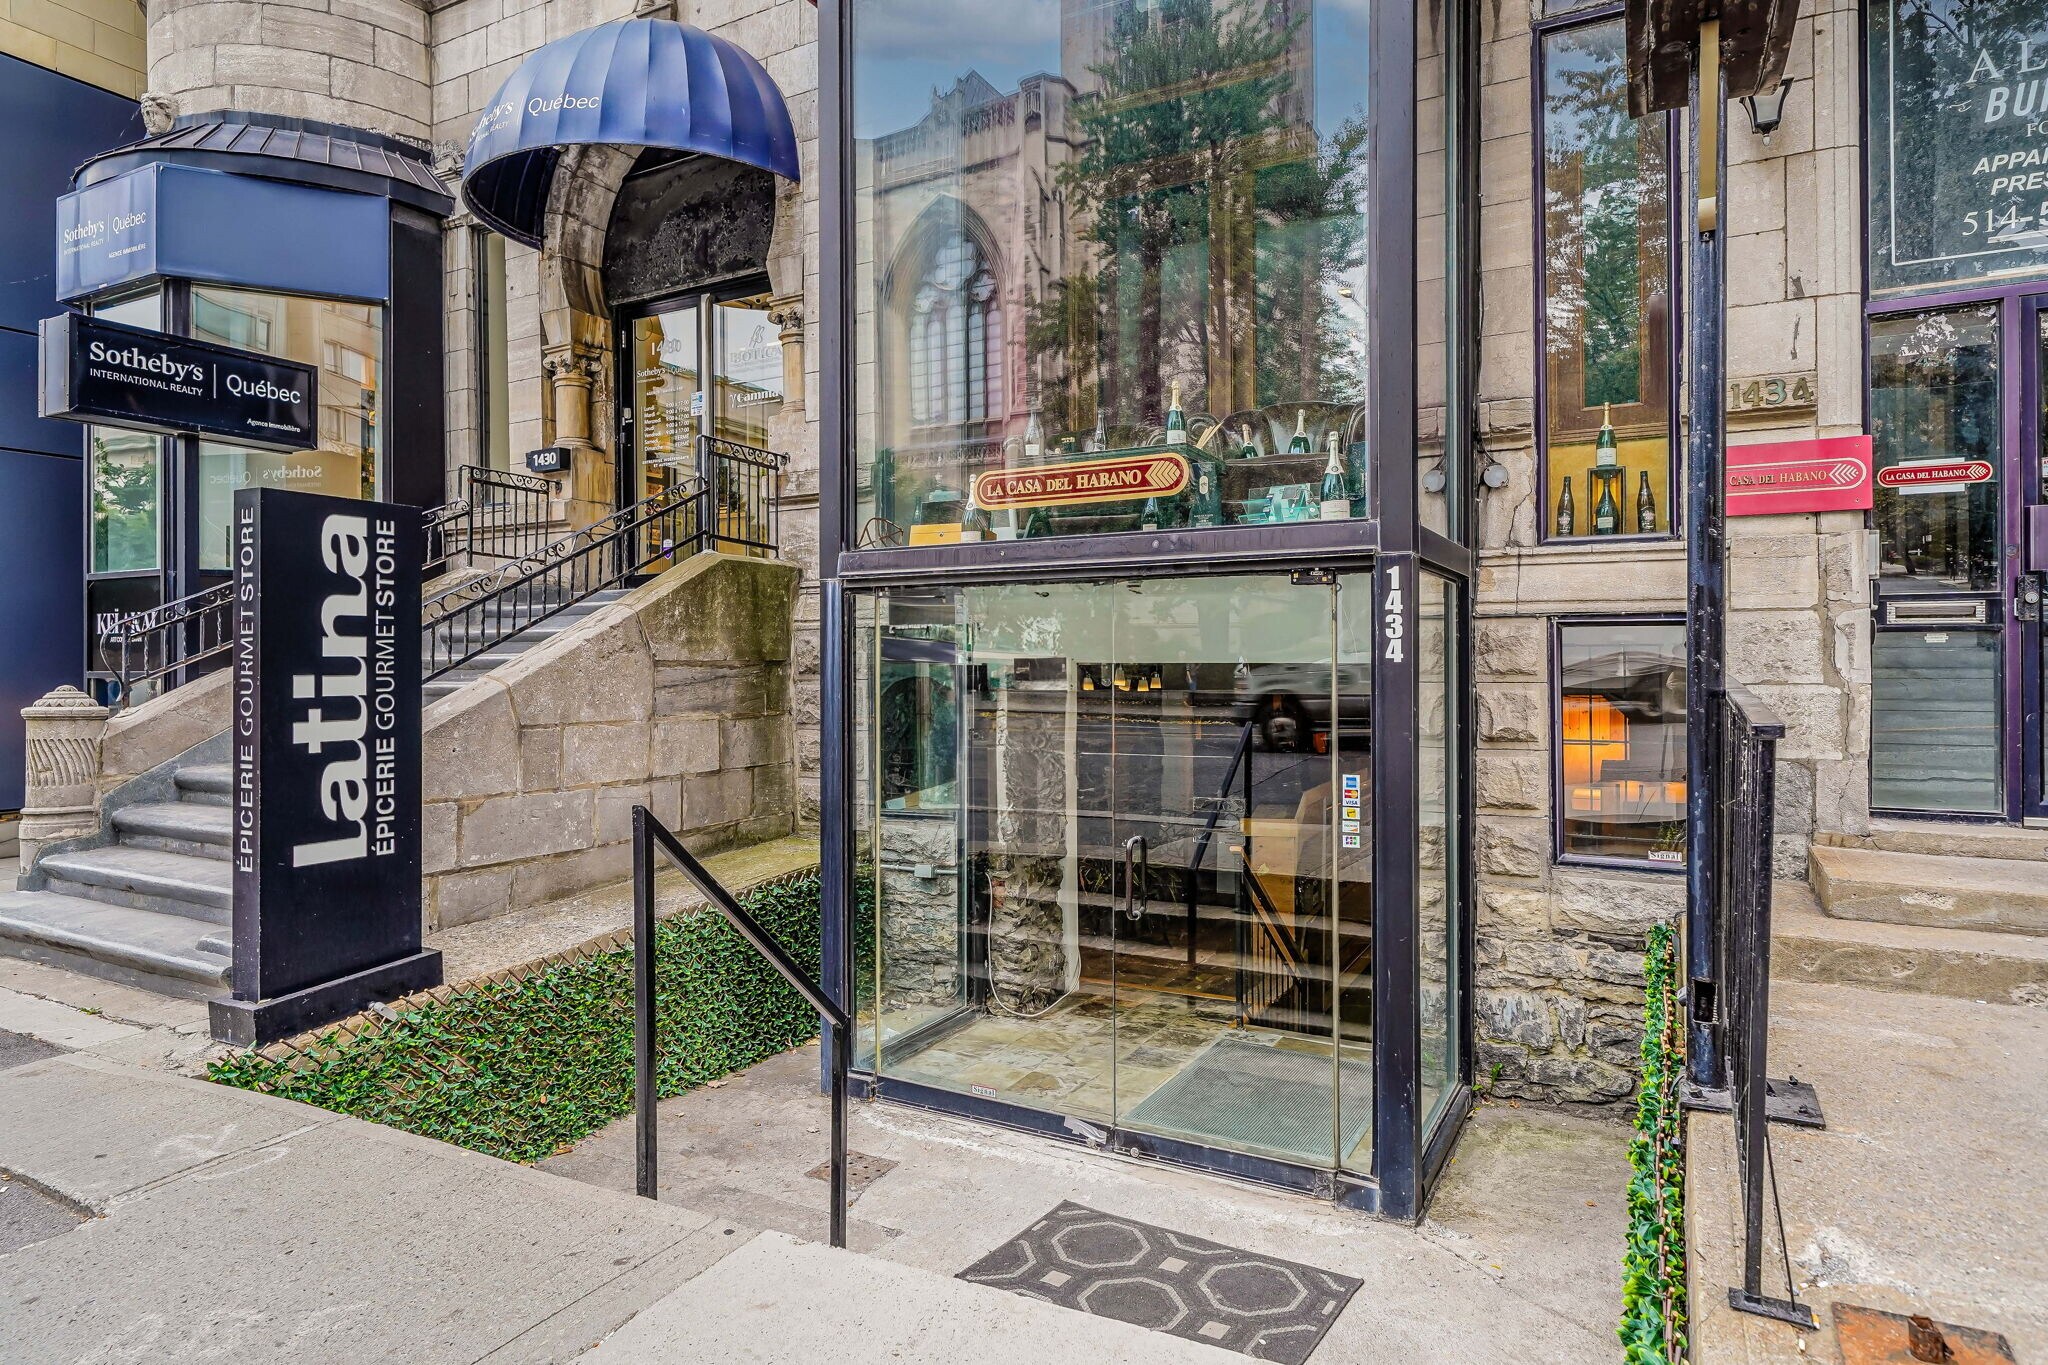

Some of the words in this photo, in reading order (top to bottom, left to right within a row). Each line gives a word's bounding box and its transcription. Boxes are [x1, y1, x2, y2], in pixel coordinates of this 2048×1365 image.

[528, 94, 600, 116] Québec
[64, 220, 105, 244] Sotheby's
[112, 211, 146, 234] Québec
[90, 341, 204, 382] Sotheby's
[226, 374, 301, 404] Québec
[90, 367, 169, 391] INTERNATIONAL
[169, 382, 203, 397] REALTY
[637, 366, 666, 378] Sotheby's
[1730, 376, 1815, 410] 1434
[532, 451, 557, 467] 1430
[1896, 472, 1915, 480] CASA
[1917, 471, 1930, 479] DEL
[1932, 469, 1966, 478] HABANO
[987, 484, 1003, 497] LA
[1006, 479, 1042, 495] CASA
[1046, 477, 1073, 492] DEL
[1076, 469, 1142, 489] HABANO
[1729, 475, 1756, 486] CASA
[1758, 474, 1777, 484] DEL
[1780, 470, 1827, 483] HABANO
[239, 506, 254, 602] STORE
[375, 519, 396, 607] STORE
[1384, 565, 1404, 663] 1434
[239, 606, 254, 737] GOURMET
[375, 609, 396, 730] GOURMET
[235, 743, 254, 873] ÉPICERIE
[371, 736, 396, 856] ÉPICERIE
[1650, 851, 1680, 860] Signal
[972, 1085, 995, 1098] Signal
